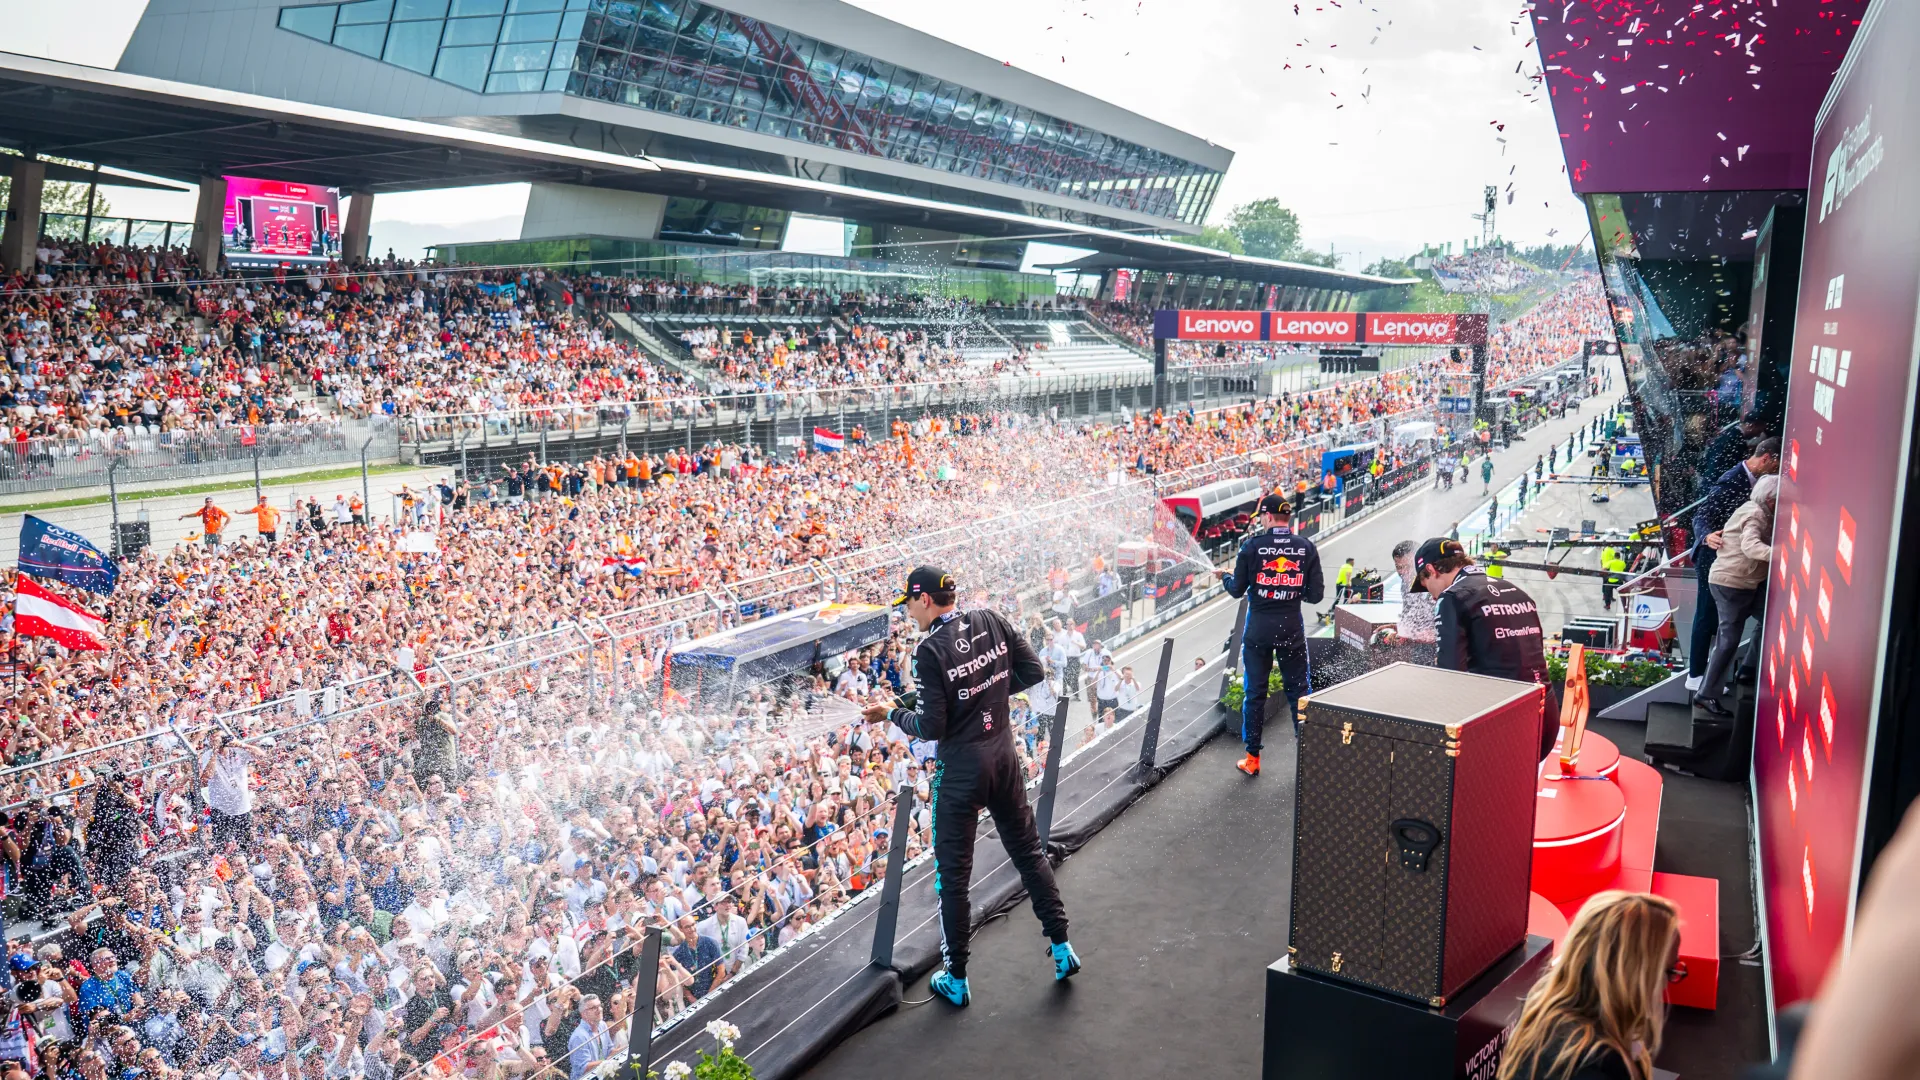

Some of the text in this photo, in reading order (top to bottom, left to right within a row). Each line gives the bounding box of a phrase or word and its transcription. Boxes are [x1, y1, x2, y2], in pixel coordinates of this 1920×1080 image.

[1185, 316, 1254, 334] Lenovo
[1277, 317, 1348, 335] Lenovo
[1373, 318, 1448, 337] Lenovo
[1258, 547, 1306, 556] ORACLE
[1256, 572, 1304, 587] Red Bull
[1258, 588, 1286, 600] Mobil
[1481, 601, 1537, 616] PETRONA
[947, 641, 1008, 682] PETRONAS
[969, 669, 1009, 697] TeamViewer
[1465, 1033, 1500, 1076] VICTORY
